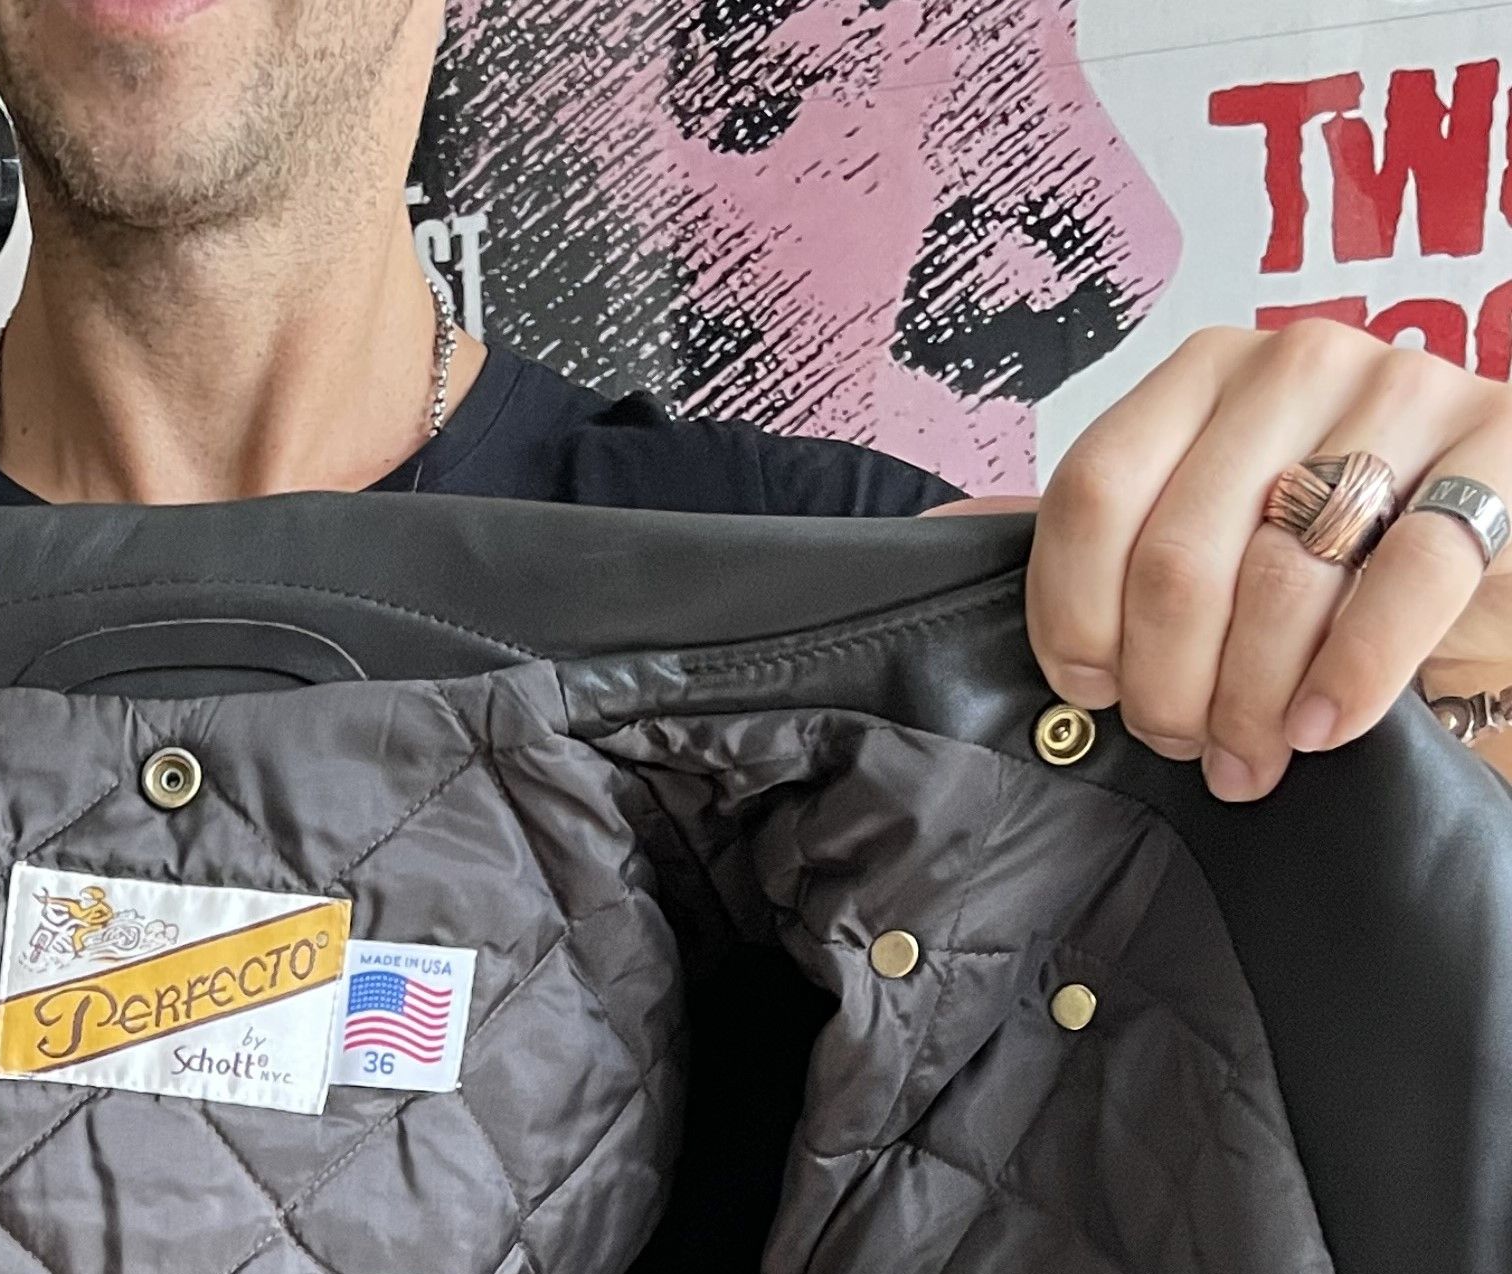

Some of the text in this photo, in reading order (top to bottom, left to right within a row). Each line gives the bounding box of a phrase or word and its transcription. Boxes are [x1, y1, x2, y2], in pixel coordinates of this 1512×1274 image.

[1208, 58, 1512, 274] TW
[360, 954, 452, 976] MADE IN USA
[242, 1026, 267, 1051] by
[170, 1045, 256, 1079] Schott
[363, 1051, 396, 1074] 36
[260, 1070, 293, 1085] NYC
